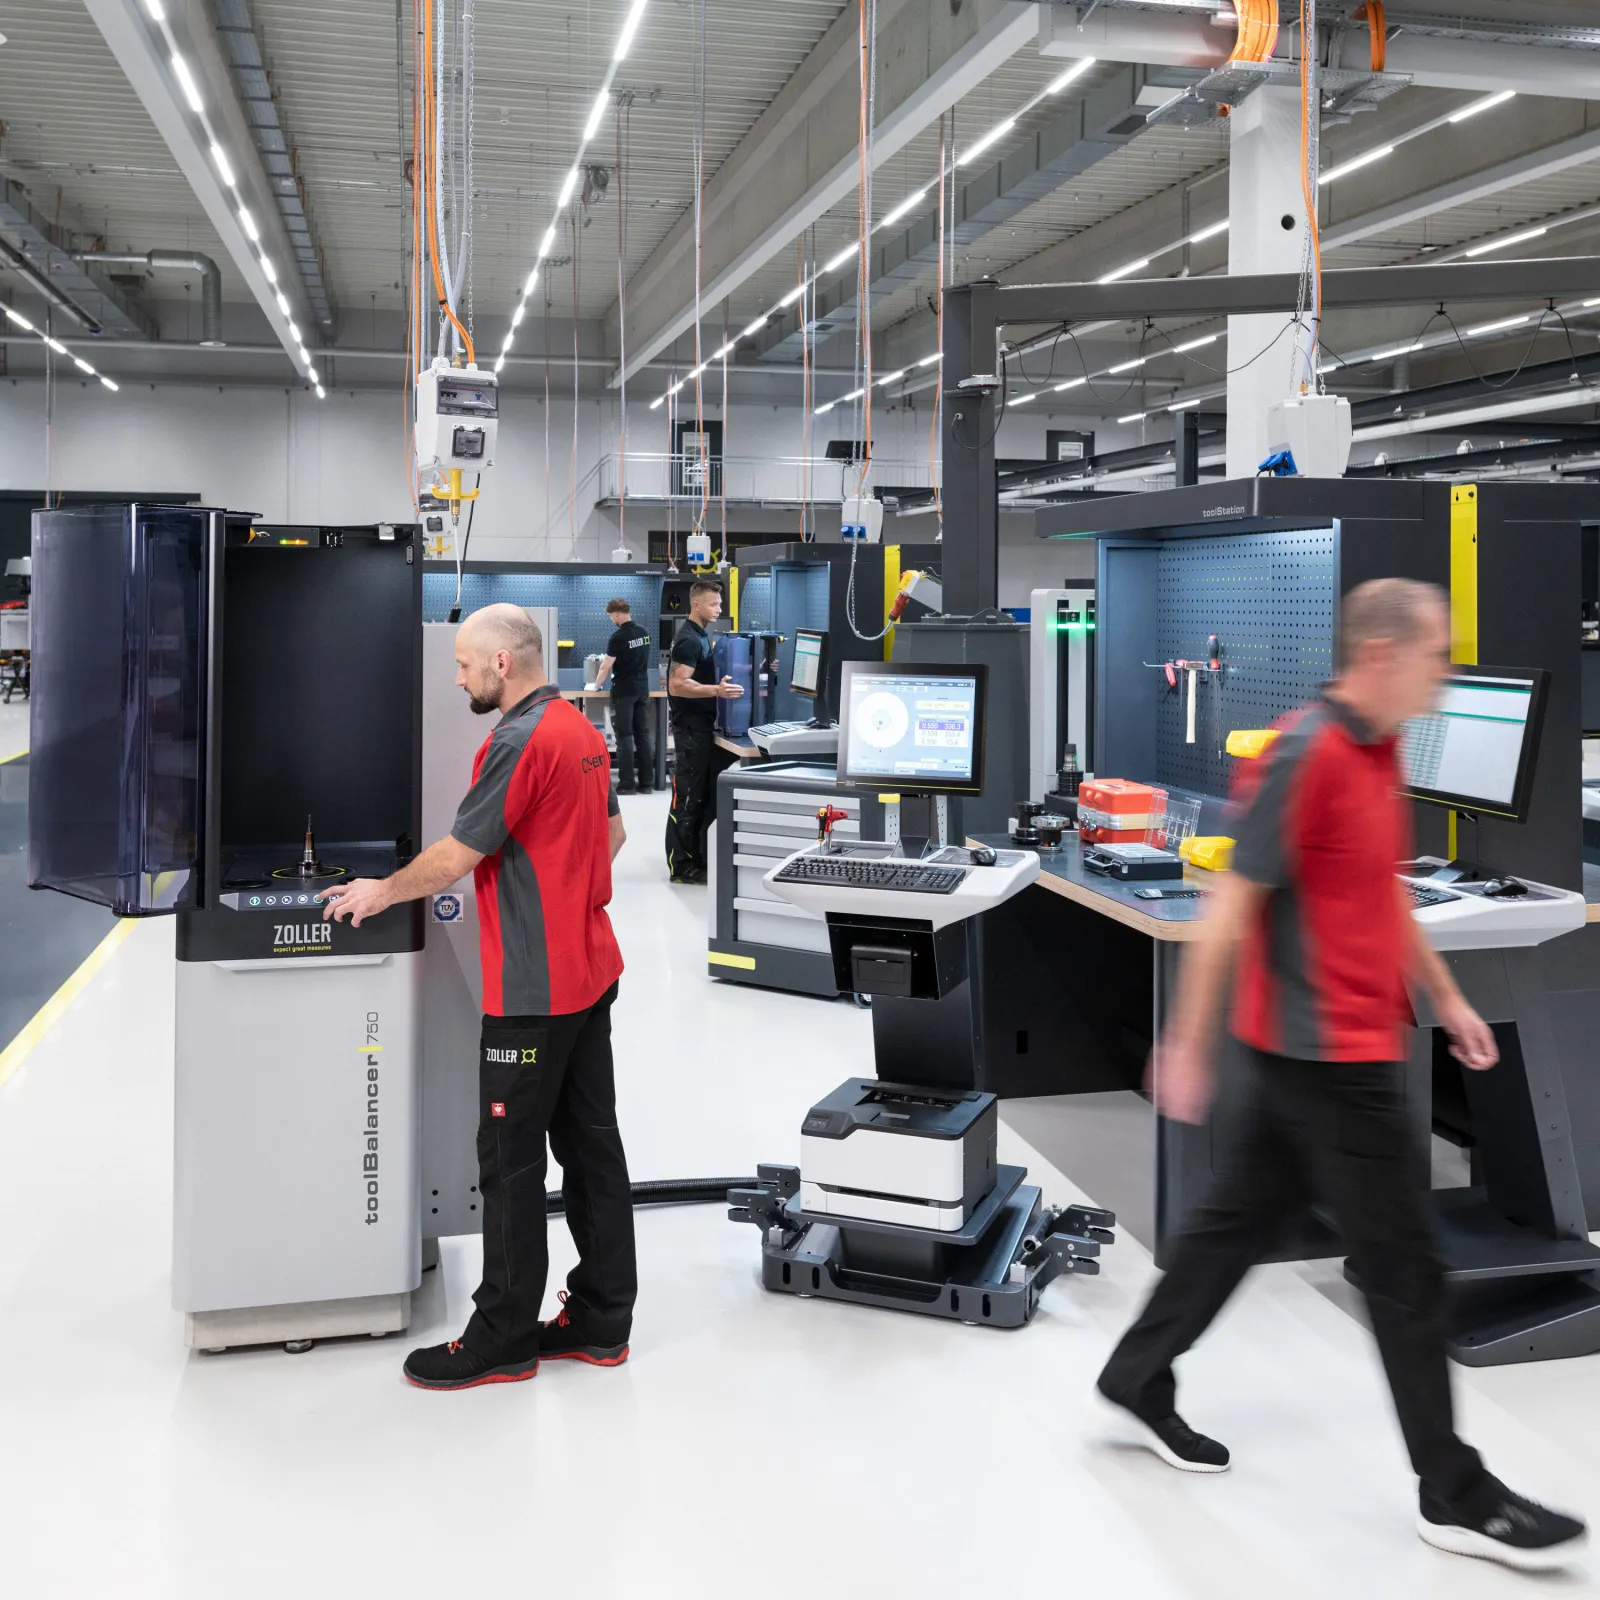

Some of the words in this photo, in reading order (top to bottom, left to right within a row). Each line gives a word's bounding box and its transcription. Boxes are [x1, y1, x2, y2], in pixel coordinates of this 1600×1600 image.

[1202, 505, 1245, 517] toolStation
[273, 923, 332, 945] ZOLLER
[366, 1011, 379, 1045] 750
[486, 1048, 518, 1064] ZOLLER
[363, 1054, 379, 1225] toolBalancer
